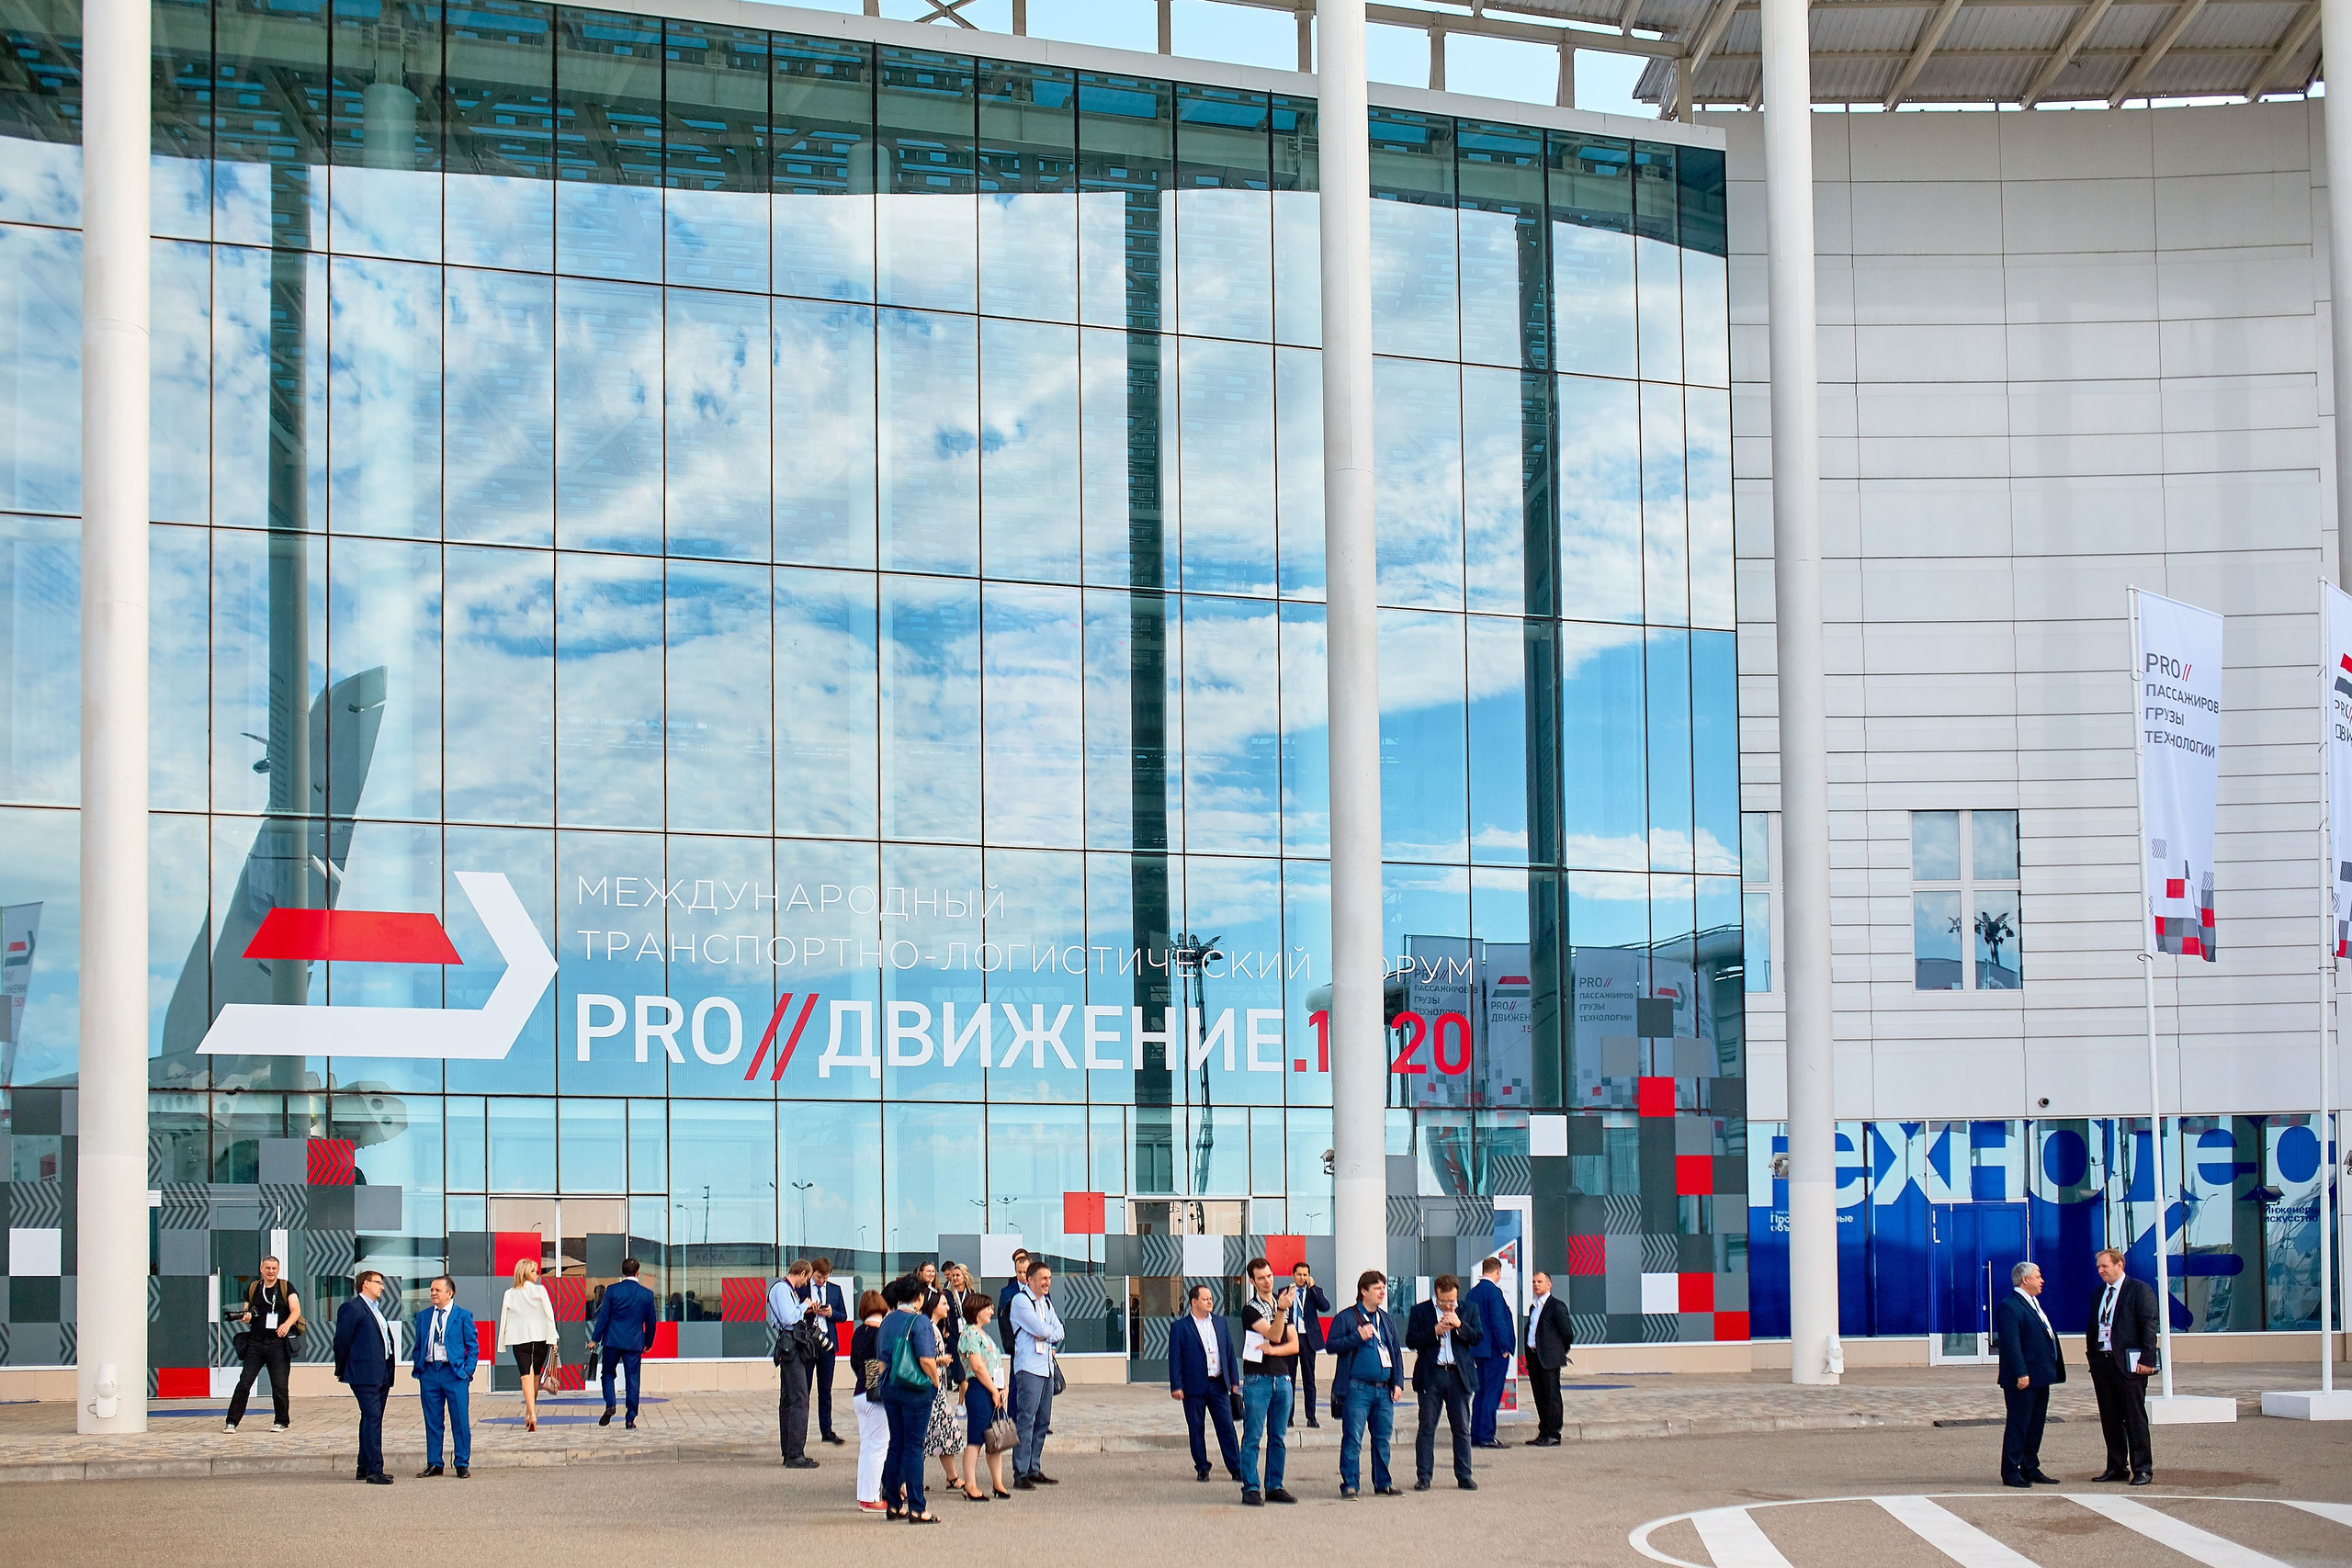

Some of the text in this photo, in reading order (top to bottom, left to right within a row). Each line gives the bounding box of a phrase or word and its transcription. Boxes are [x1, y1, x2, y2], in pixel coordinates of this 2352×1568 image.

[2145, 652, 2192, 682] PRO//
[2145, 683, 2219, 714] ПАССАЖИРОВ
[2145, 707, 2184, 726] ГРУЗЫ
[2144, 730, 2215, 759] ТЕХНОЛОГИИ
[578, 875, 1004, 922] МЕЖДУНАРОДНЫЙ
[577, 930, 1310, 981] ТРАНСПОРТНО-ЛОГИСТИЧЕСКИЙ
[1491, 1013, 1532, 1022] ДВИЖЕН
[1579, 1003, 1605, 1011] ГРУЗЫ
